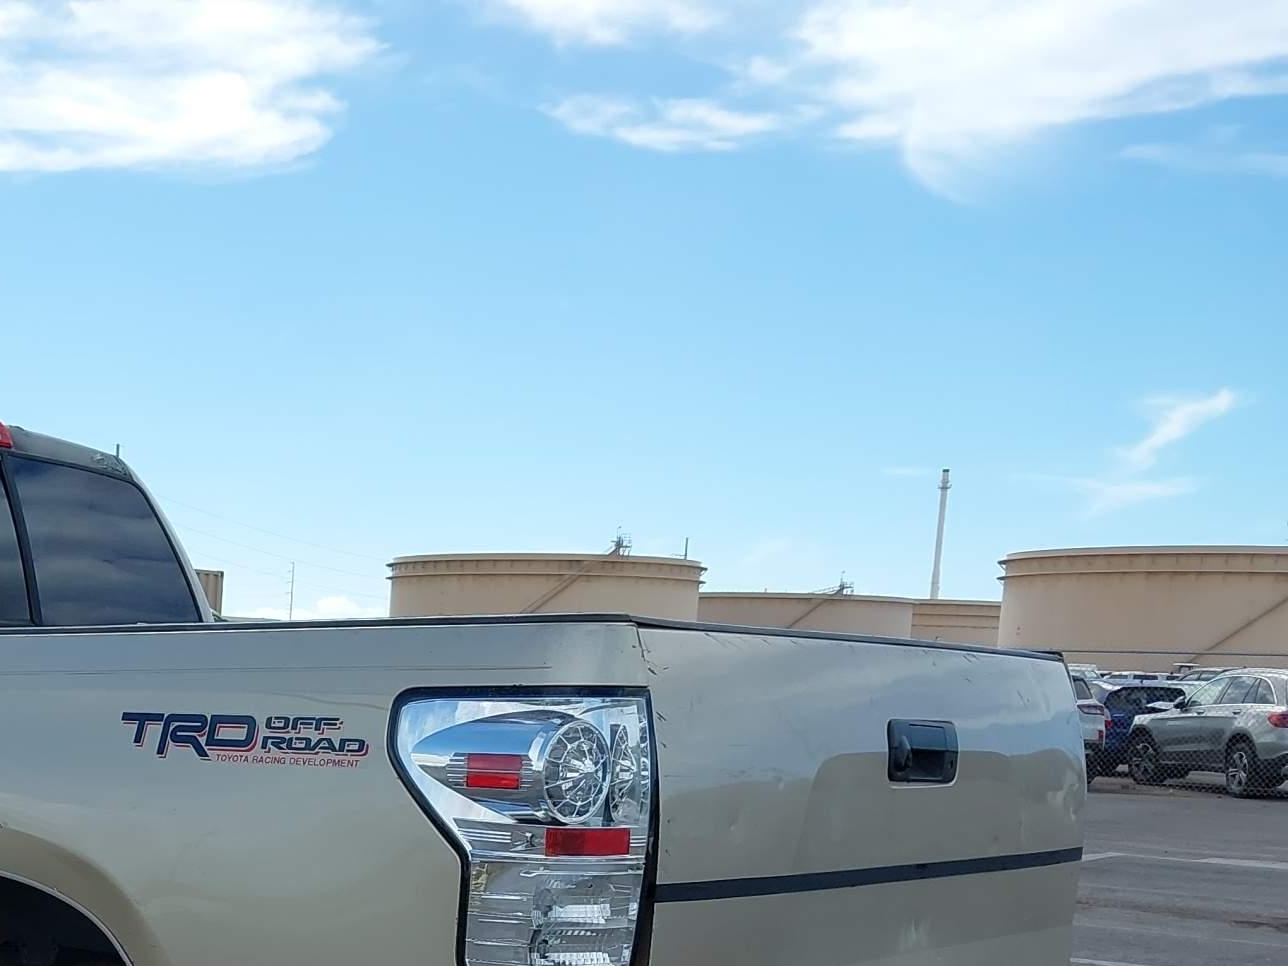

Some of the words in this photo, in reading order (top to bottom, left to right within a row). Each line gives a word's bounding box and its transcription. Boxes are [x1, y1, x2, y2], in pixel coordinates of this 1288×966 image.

[263, 716, 344, 735] OFF
[121, 711, 260, 761] TRD
[261, 736, 369, 757] ROAD
[215, 754, 249, 764] TOYOTA
[252, 755, 286, 766] RACING
[289, 757, 360, 768] DEVELOPMENT
